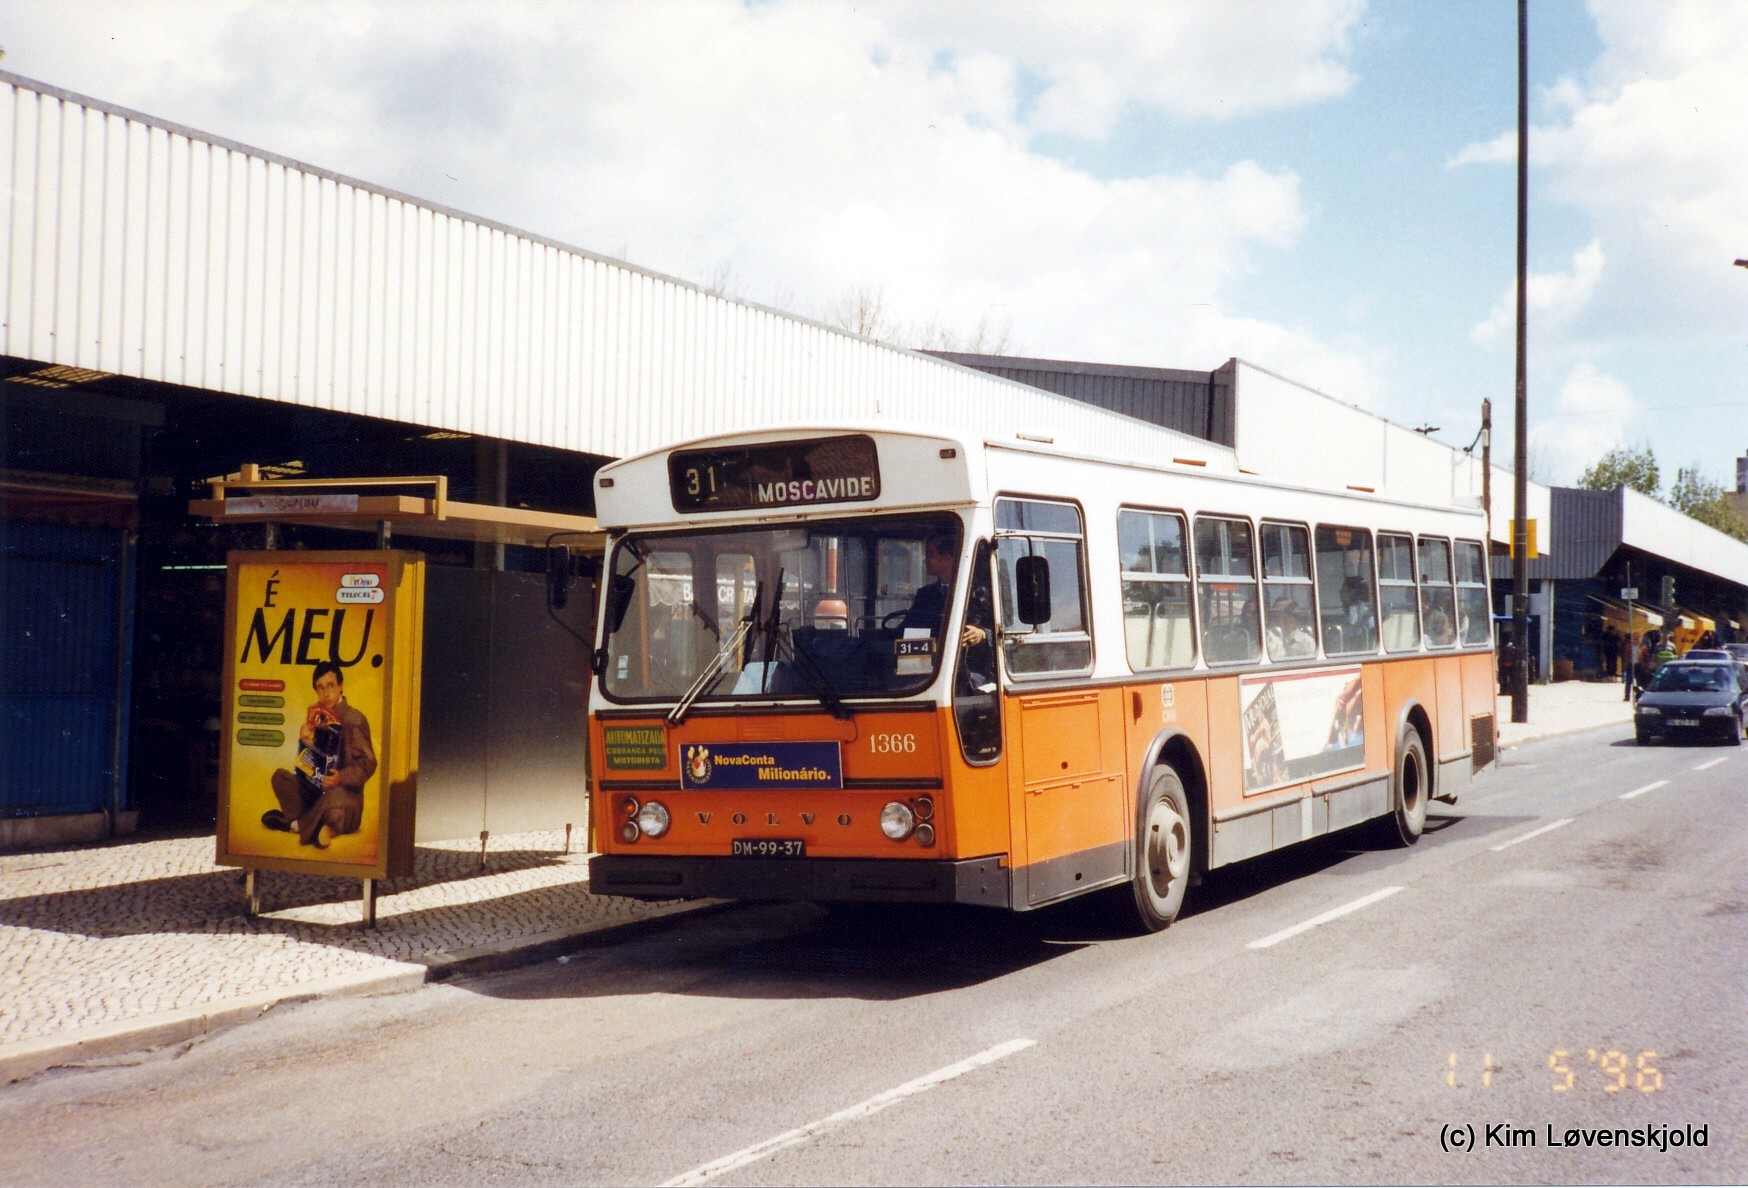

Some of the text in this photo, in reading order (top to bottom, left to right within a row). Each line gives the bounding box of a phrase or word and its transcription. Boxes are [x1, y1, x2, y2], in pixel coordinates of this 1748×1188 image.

[685, 465, 872, 503] 31 MOSCAVIDE
[264, 570, 280, 608] É
[240, 607, 384, 669] MEU.
[870, 733, 916, 753] 1366
[714, 754, 776, 766] NovaConta
[758, 767, 831, 780] Milionário.
[695, 812, 852, 827] VOLVO
[733, 841, 803, 856] DM-99-37
